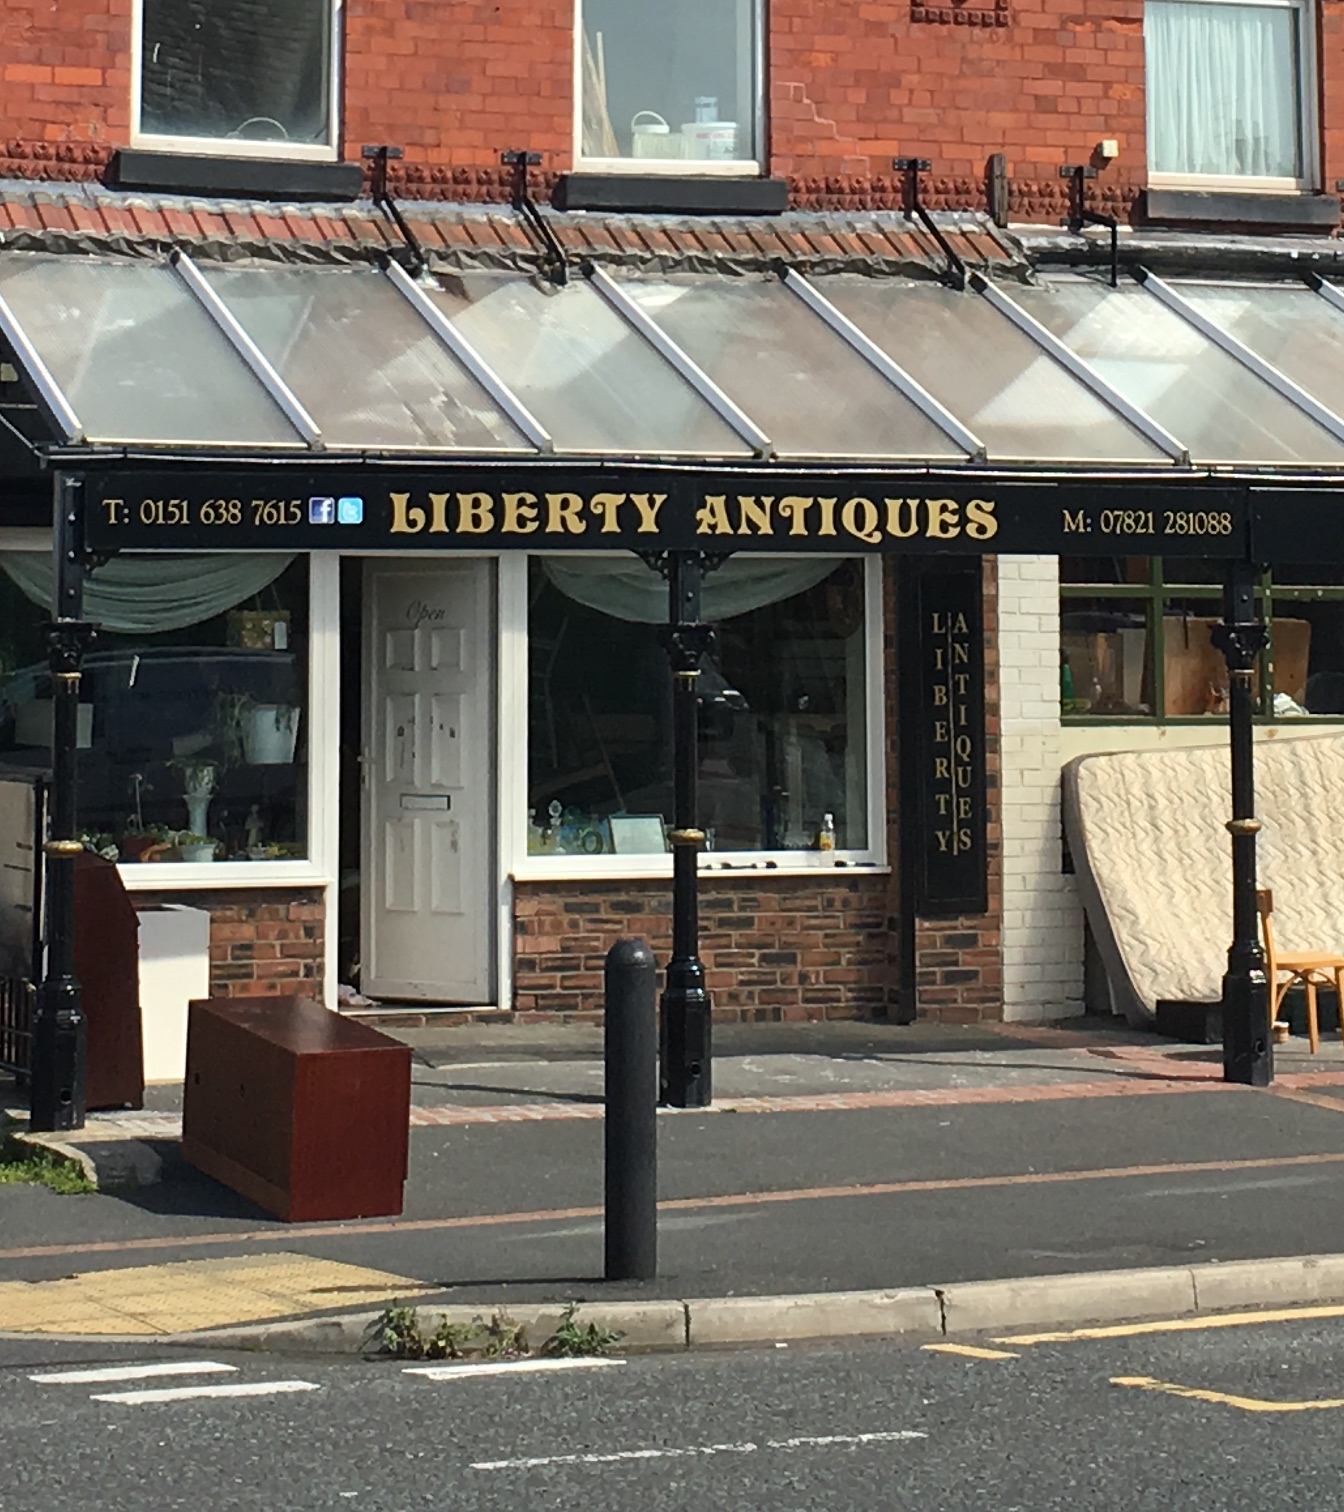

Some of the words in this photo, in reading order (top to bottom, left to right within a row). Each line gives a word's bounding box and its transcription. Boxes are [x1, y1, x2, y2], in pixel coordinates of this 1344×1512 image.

[102, 499, 129, 524] T:
[140, 499, 190, 524] 0151
[200, 499, 242, 524] 638
[251, 499, 302, 525] 7615
[389, 492, 668, 534] LIBERTY
[695, 494, 998, 544] ANTIQUES
[1062, 509, 1092, 533] M:
[1100, 509, 1155, 534] 07821
[1163, 511, 1232, 535] 281088
[406, 600, 446, 629] Open
[931, 612, 951, 852] LIBERTY
[953, 612, 973, 851] ANTIQUES
